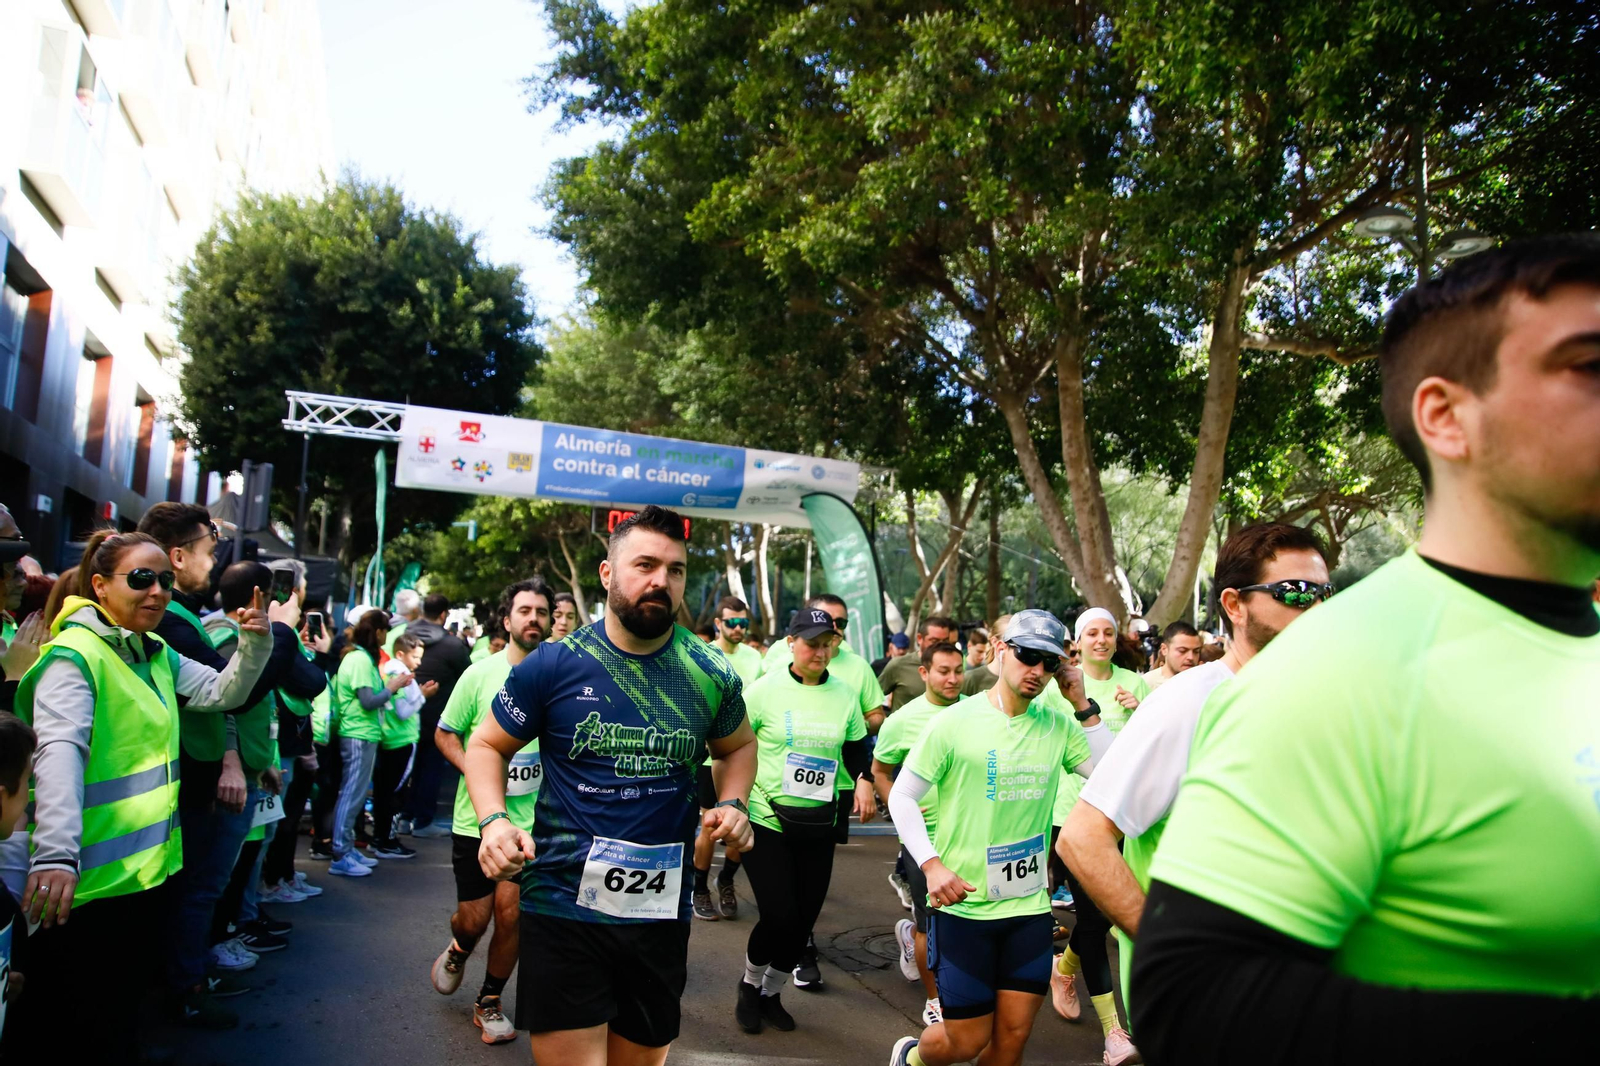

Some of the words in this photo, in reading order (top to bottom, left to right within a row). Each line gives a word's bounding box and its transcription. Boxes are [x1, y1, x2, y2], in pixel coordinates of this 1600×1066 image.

[555, 433, 631, 457] Almería
[636, 447, 660, 460] en
[666, 449, 735, 469] marcha
[552, 457, 617, 477] contra
[622, 463, 640, 480] el
[646, 467, 711, 487] cáncer
[811, 610, 827, 623] K
[615, 725, 644, 740] Carrera
[644, 727, 695, 761] Cortijo
[795, 737, 838, 748] cáncer
[508, 764, 541, 781] 408
[985, 749, 997, 801] ALMERÍA
[1000, 764, 1012, 773] En
[1015, 763, 1050, 773] marcha
[794, 768, 825, 786] 608
[1000, 774, 1036, 785] contra
[1039, 773, 1049, 783] el
[998, 787, 1047, 802] cáncer
[256, 797, 274, 812] 78
[1002, 855, 1039, 881] 164
[604, 867, 666, 894] 624
